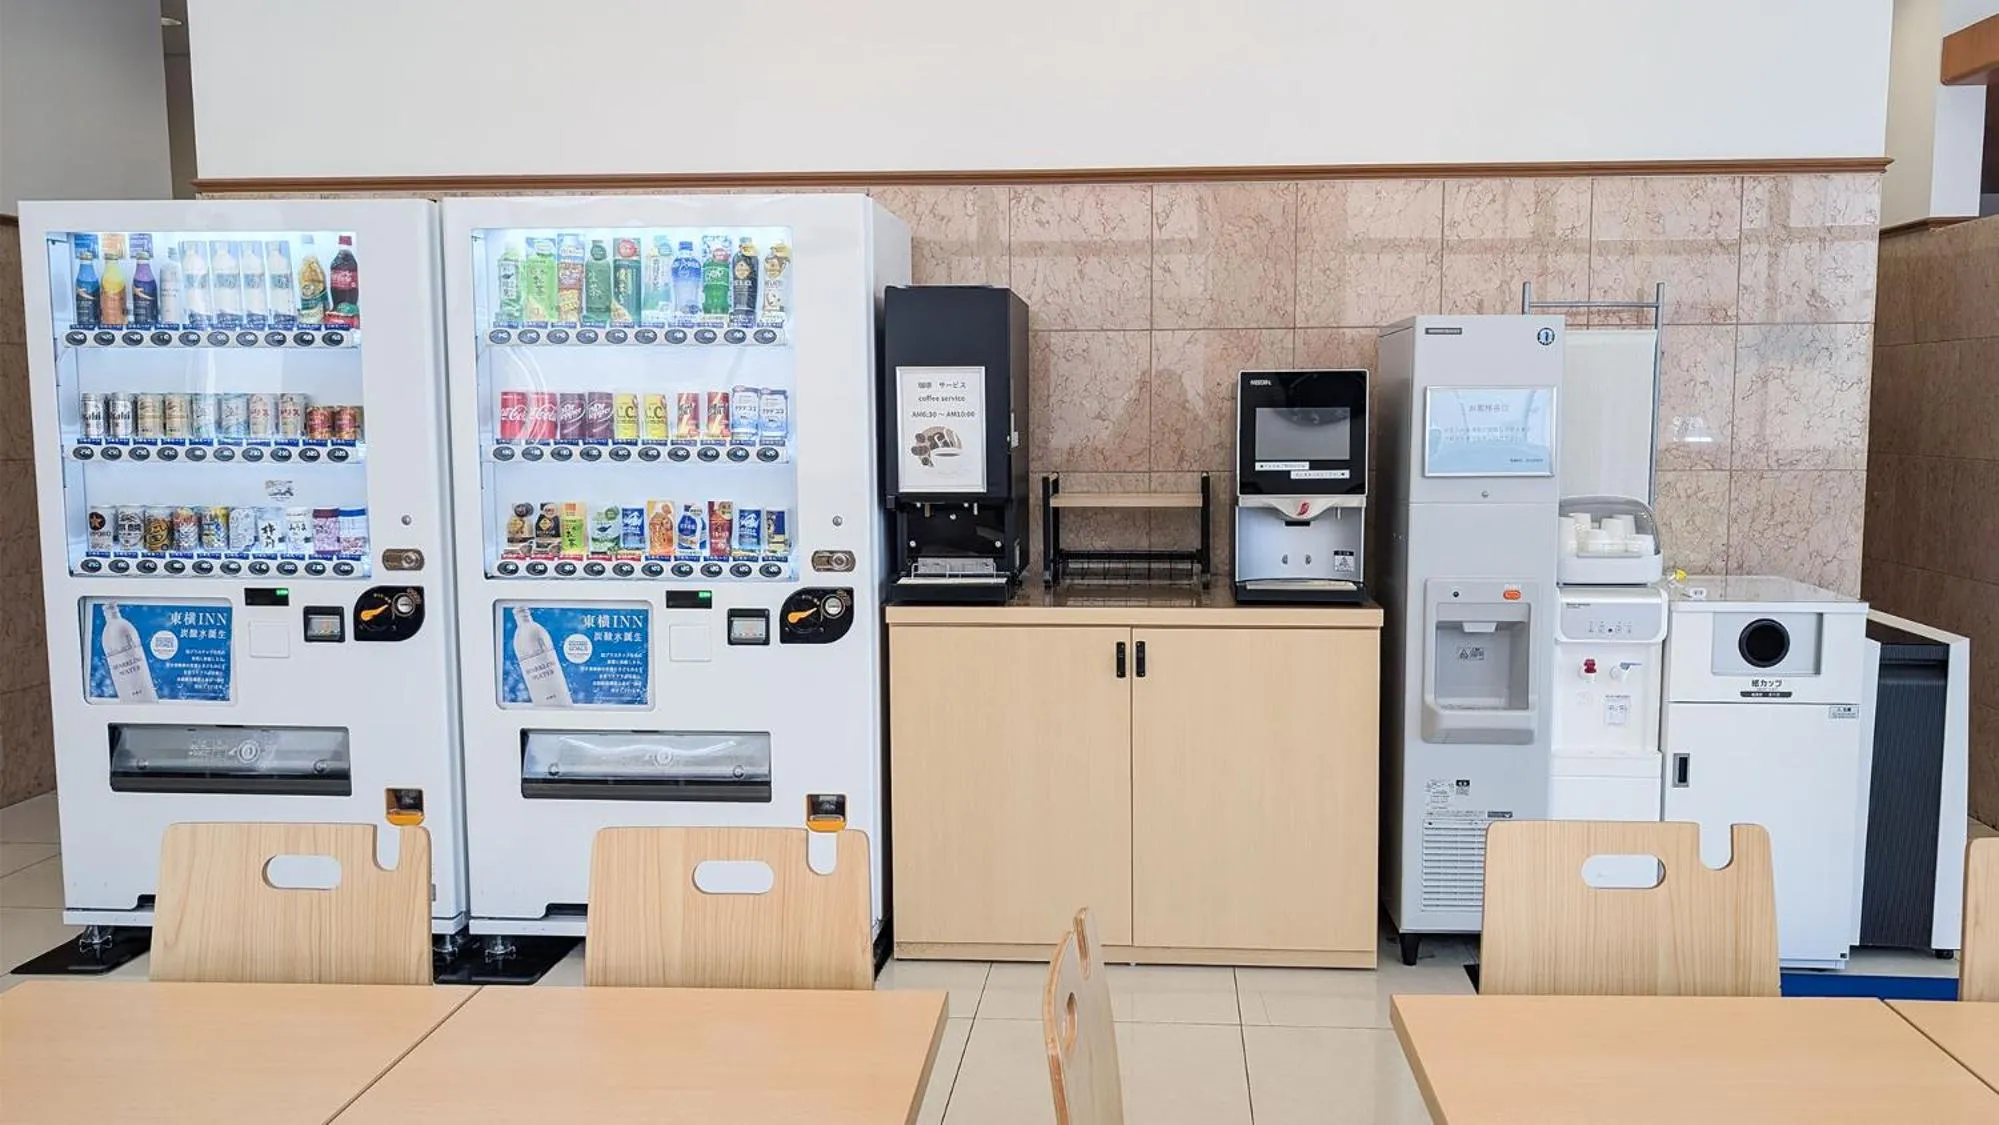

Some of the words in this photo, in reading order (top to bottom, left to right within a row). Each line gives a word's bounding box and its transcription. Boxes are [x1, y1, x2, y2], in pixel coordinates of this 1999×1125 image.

[938, 381, 967, 389] サービス
[170, 611, 227, 626] 東横INN
[583, 614, 643, 629] 東横INN
